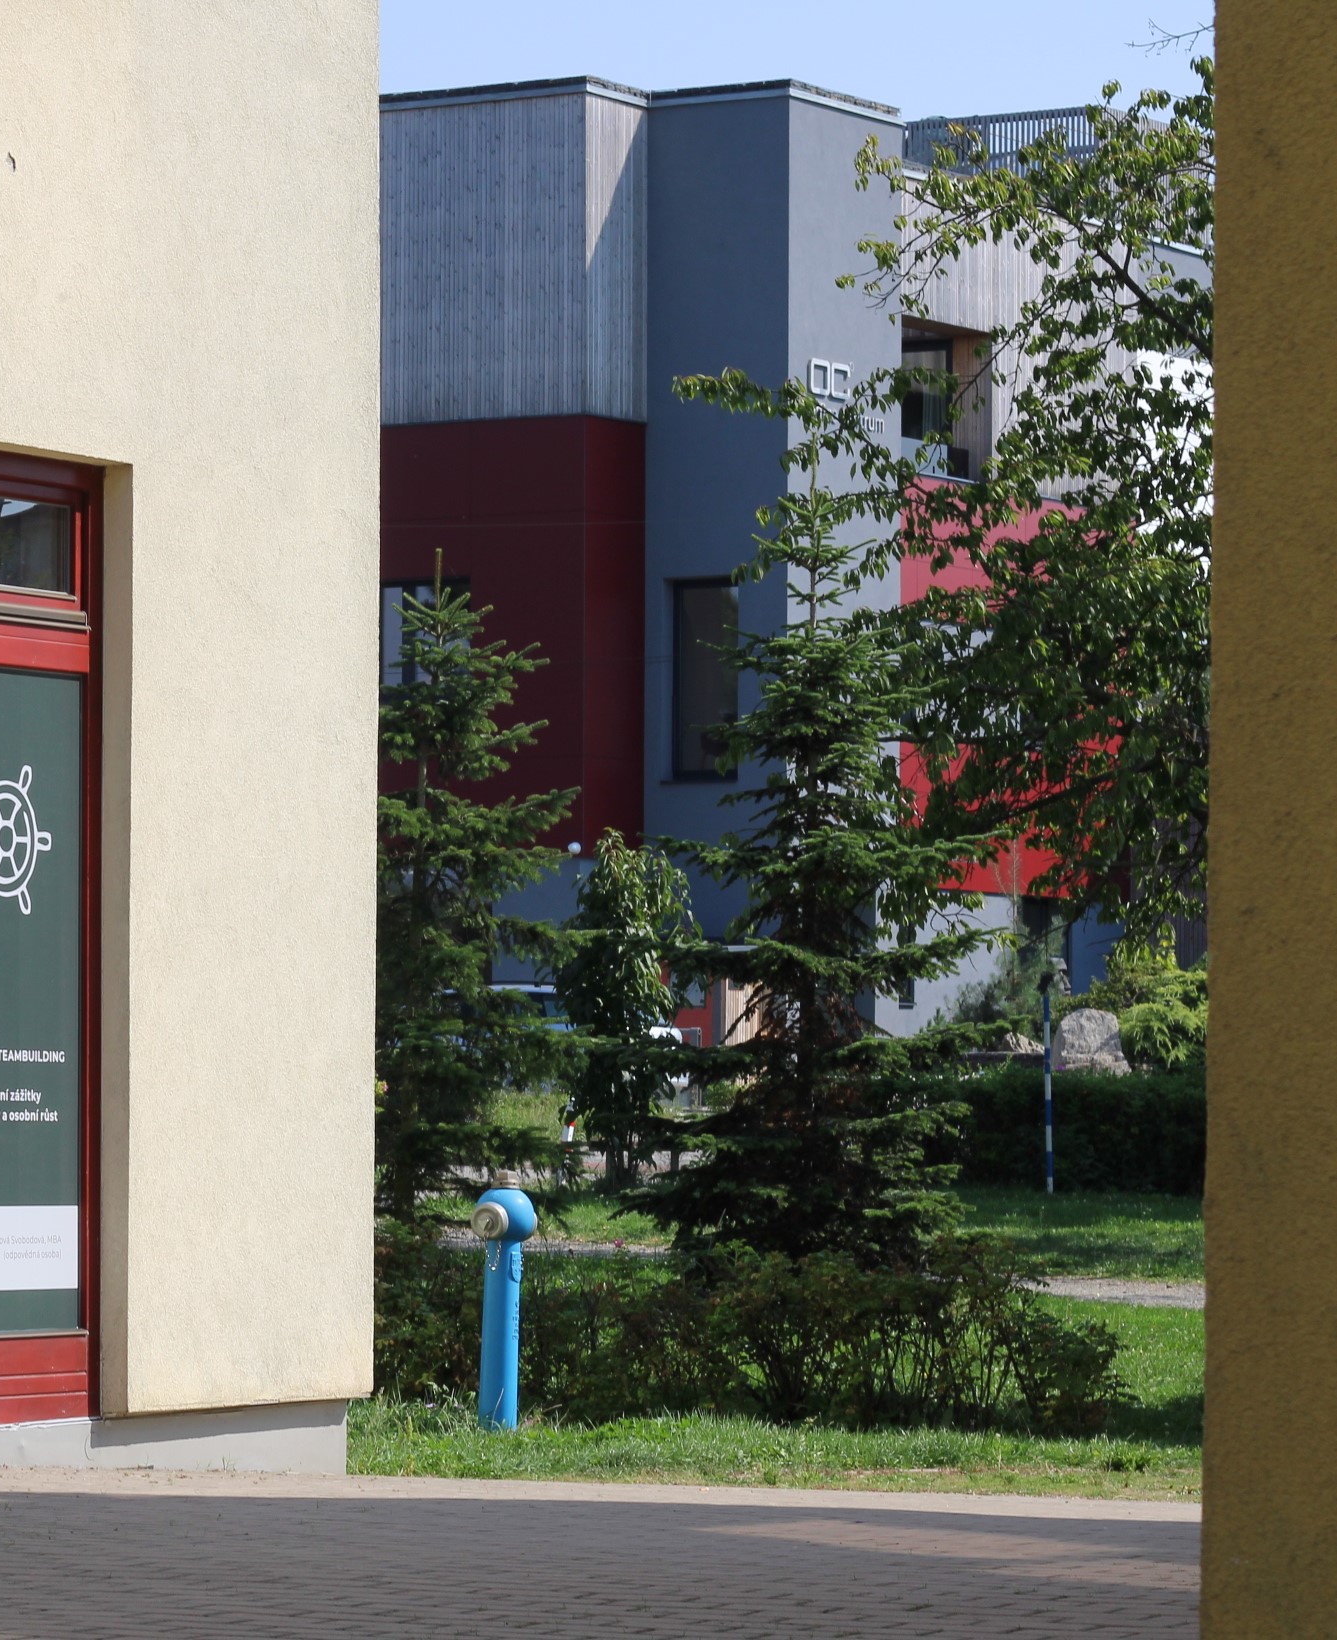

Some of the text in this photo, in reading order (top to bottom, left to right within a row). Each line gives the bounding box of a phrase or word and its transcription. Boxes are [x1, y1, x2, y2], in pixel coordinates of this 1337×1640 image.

[10, 1089, 41, 1104] zážitky
[2, 1112, 7, 1121] a
[9, 1109, 39, 1121] osobní
[40, 1110, 58, 1122] růst
